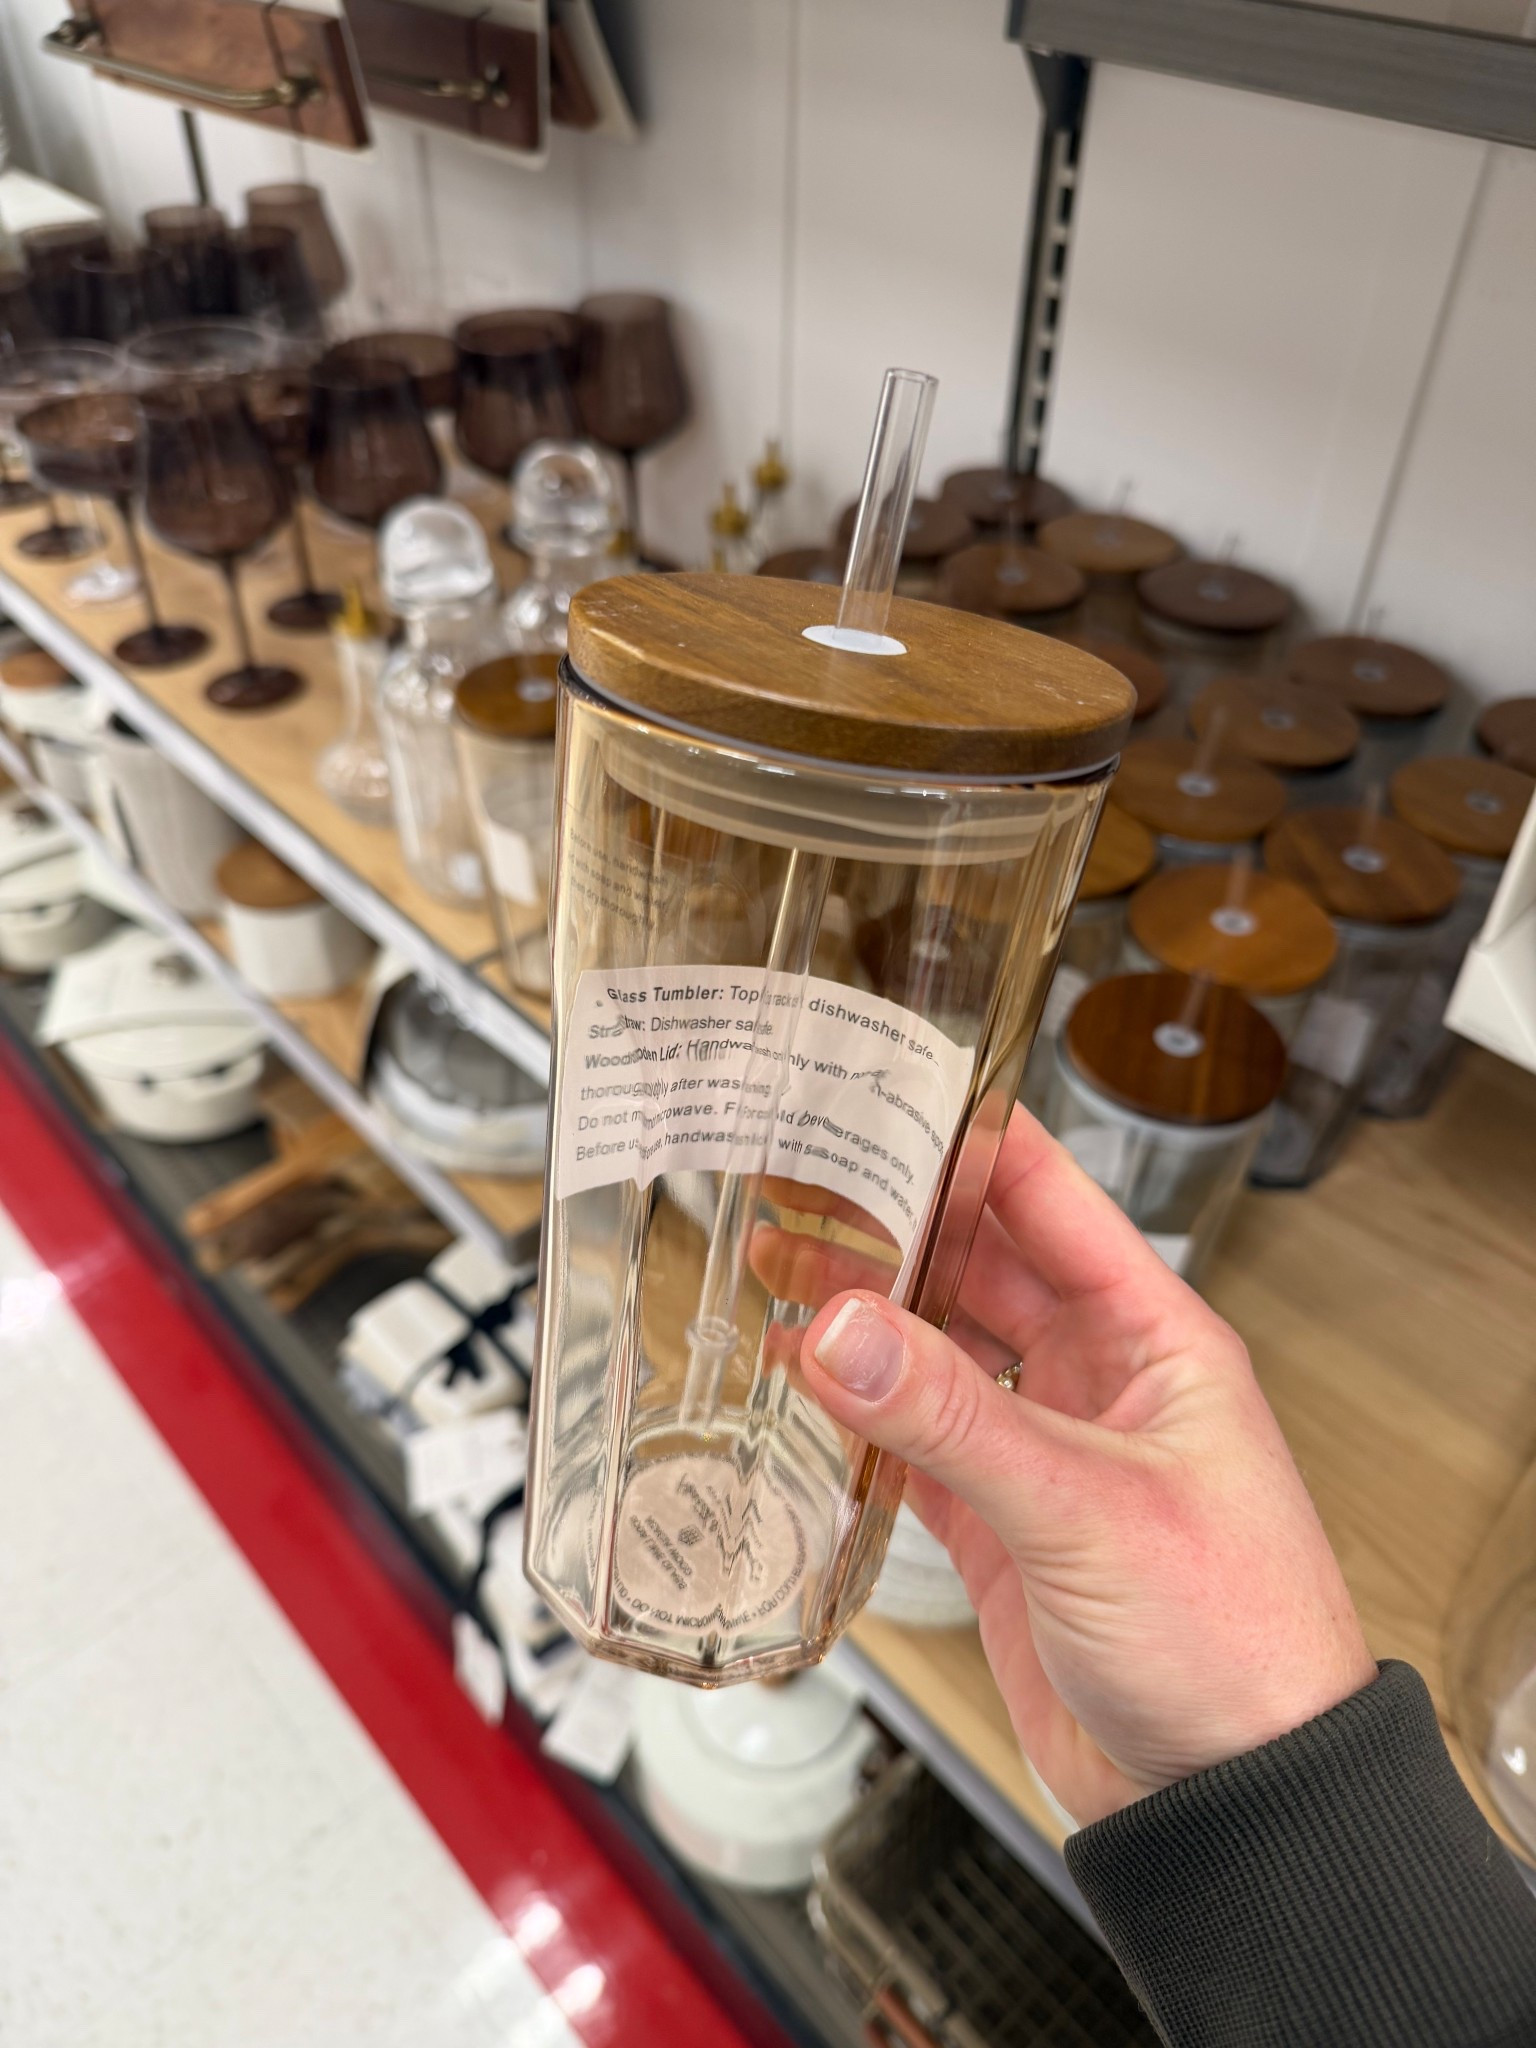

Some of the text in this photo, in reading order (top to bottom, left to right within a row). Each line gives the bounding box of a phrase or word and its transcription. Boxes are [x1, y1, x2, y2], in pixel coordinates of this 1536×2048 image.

[607, 987, 647, 1003] Glass
[653, 985, 724, 1002] Tumbler:
[730, 985, 760, 1005] Top
[808, 997, 907, 1046] dishwasher
[651, 1015, 732, 1033] Dishwasher
[660, 1043, 683, 1062] Lid:
[813, 1059, 848, 1080] with
[670, 1077, 704, 1093] after
[576, 1140, 625, 1162] Before
[778, 1137, 803, 1155] with
[863, 1166, 890, 1191] and
[578, 1115, 598, 1131] Do
[602, 1110, 628, 1126] not
[889, 1157, 915, 1186] only.
